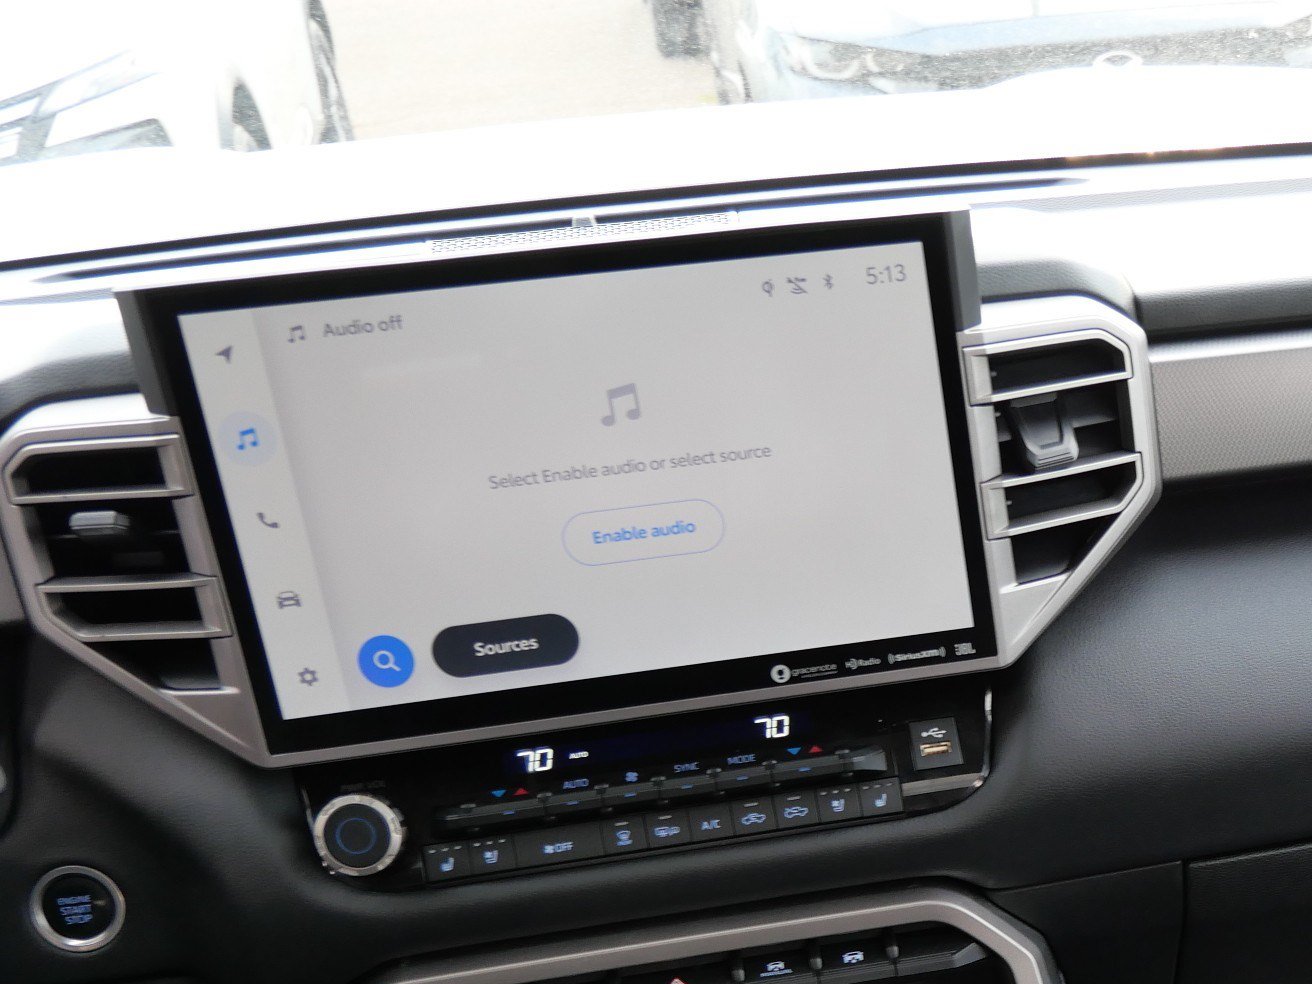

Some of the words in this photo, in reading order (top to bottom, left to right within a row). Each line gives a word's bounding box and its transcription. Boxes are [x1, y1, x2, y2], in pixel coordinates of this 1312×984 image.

[865, 264, 907, 285] 5:13
[323, 319, 374, 337] Audio
[377, 314, 403, 332] off
[488, 473, 540, 490] Select
[541, 464, 598, 483] Enable
[600, 458, 647, 477] audio
[649, 456, 666, 471] or
[669, 449, 717, 470] select
[719, 444, 772, 463] source
[591, 525, 648, 545] Enable
[650, 520, 697, 538] audio
[473, 638, 540, 657] Sources
[858, 657, 882, 668] Radio
[754, 714, 790, 739] 70
[516, 748, 554, 773] 70
[726, 753, 757, 766] MODE
[673, 761, 700, 774] SYNC
[562, 778, 590, 790] AUTO
[701, 818, 722, 831] A/C
[555, 841, 575, 853] OFF
[56, 894, 92, 906] ENGINE
[60, 904, 92, 916] START
[65, 913, 93, 925] STOP
